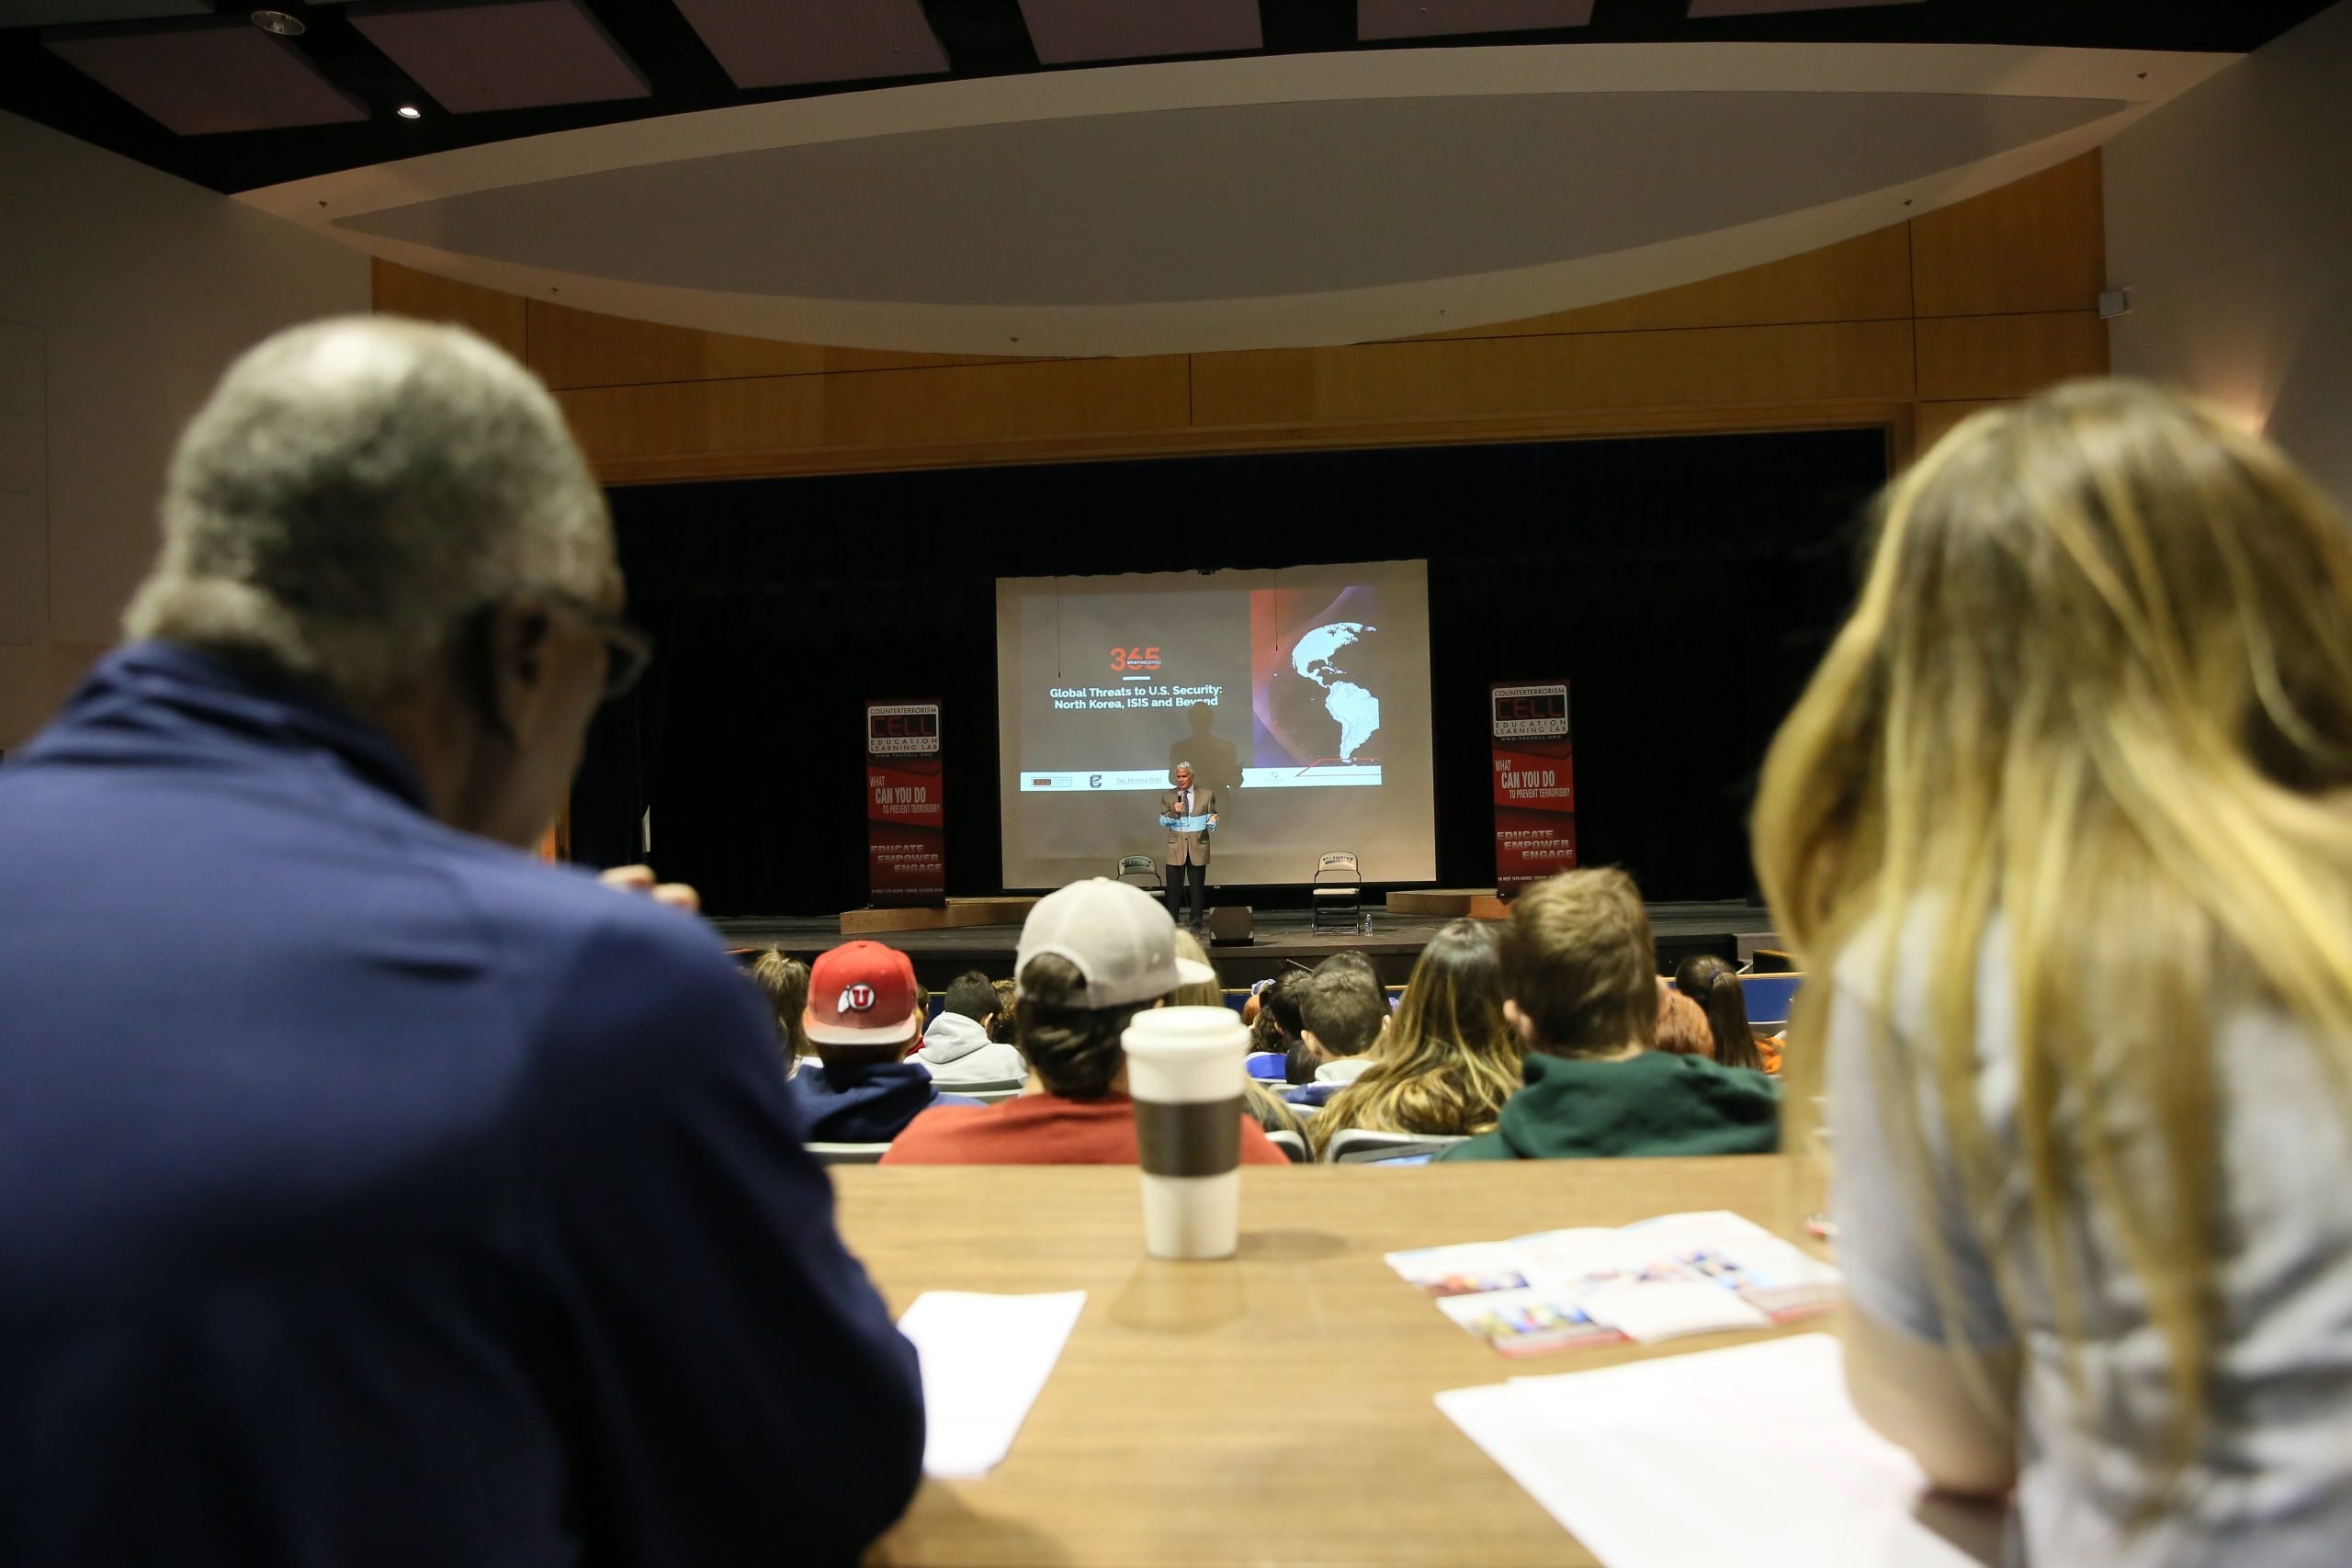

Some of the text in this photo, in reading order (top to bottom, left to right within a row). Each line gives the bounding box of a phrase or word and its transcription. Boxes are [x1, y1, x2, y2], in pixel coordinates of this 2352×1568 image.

[1110, 647, 1161, 671] 365
[1050, 684, 1223, 698] Global Threats to U.S. Security:
[1495, 688, 1564, 696] COUNTERTERRORISM
[1055, 699, 1086, 709] North
[1089, 699, 1125, 710] Korea,
[1127, 698, 1148, 708] ISIS
[1151, 697, 1172, 707] and
[1496, 697, 1564, 719] CELL
[871, 716, 935, 736] CELL
[1496, 719, 1566, 728] EDUCATION
[1496, 727, 1544, 735] LEARNING
[1495, 759, 1511, 772] WHAT
[869, 775, 885, 787] WHAT
[1501, 770, 1555, 789] CAN YOU DO
[876, 786, 926, 804] CAN YOU DO
[1509, 787, 1570, 799] TO PREVENT TERRORISM?
[882, 805, 889, 814] TO
[889, 804, 910, 814] PREVENT
[1497, 830, 1554, 839] EDUCATE
[1504, 840, 1569, 850] EMPOWER
[877, 854, 939, 863] EMPOWER
[1521, 850, 1573, 860] ENGAGE
[894, 864, 942, 873] ENGAGE
[852, 988, 871, 1007] U
